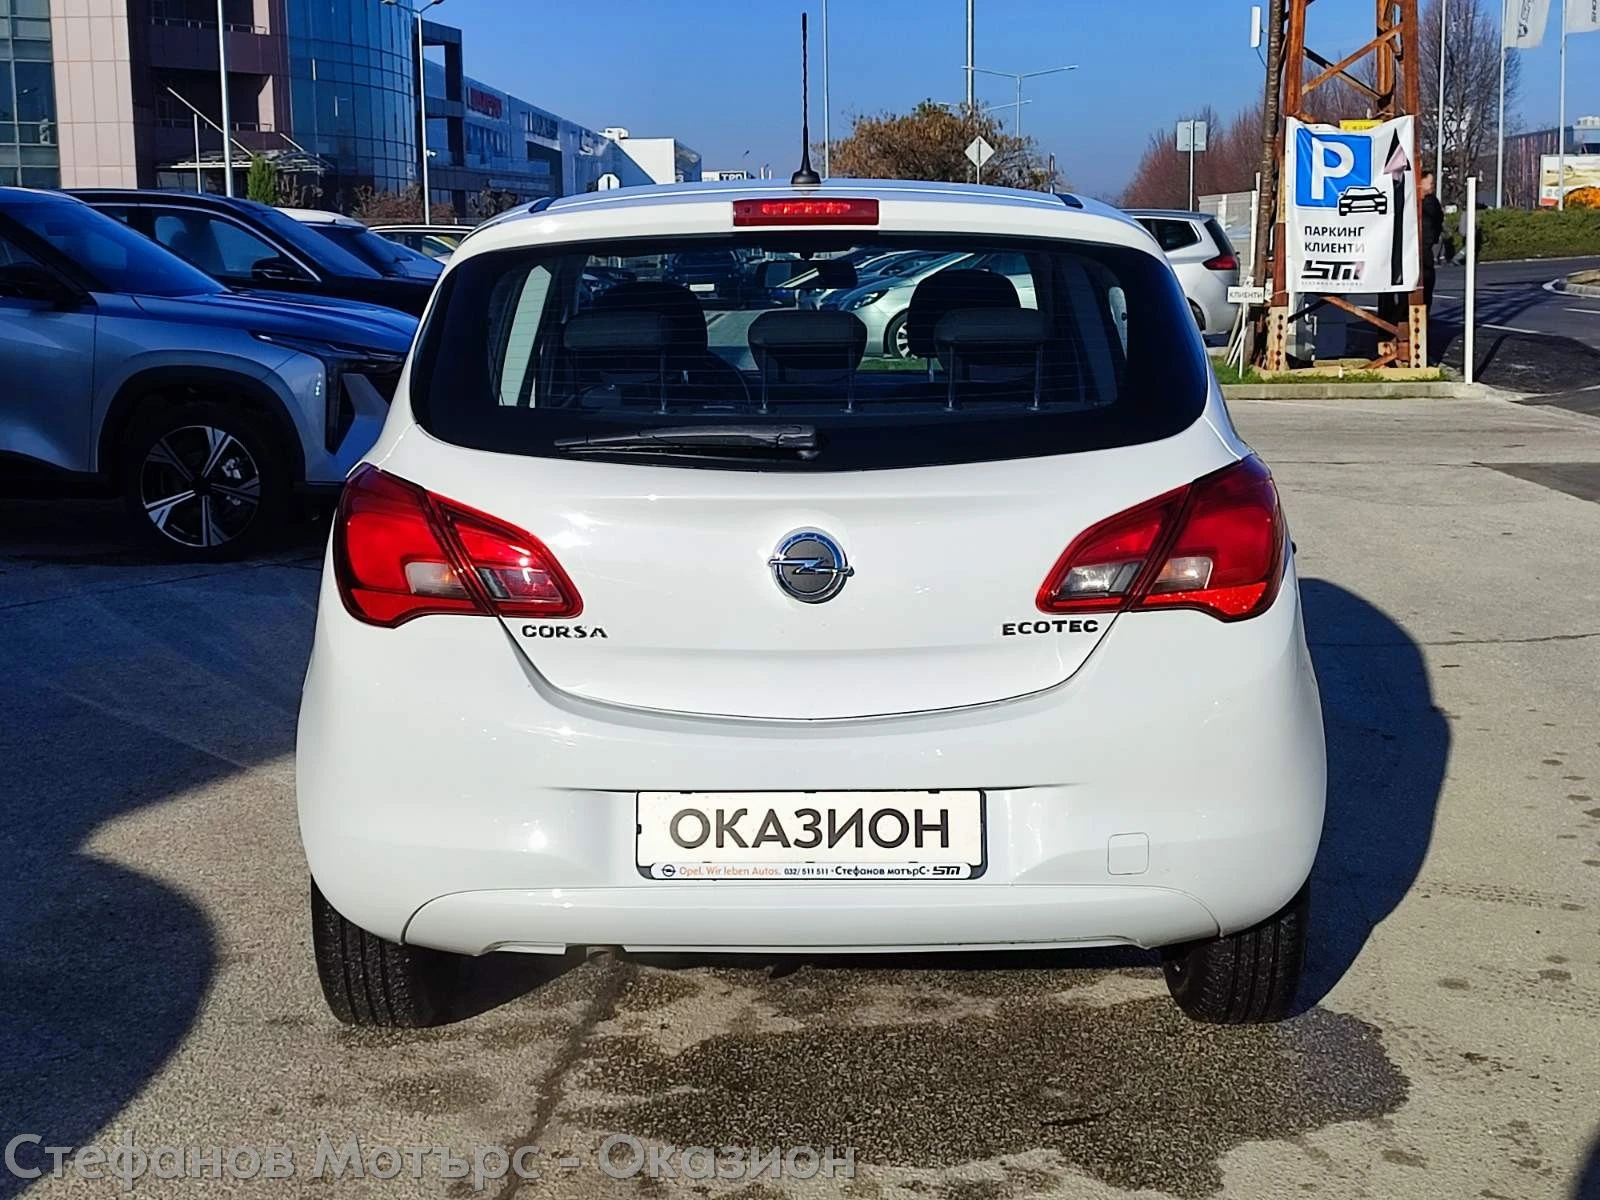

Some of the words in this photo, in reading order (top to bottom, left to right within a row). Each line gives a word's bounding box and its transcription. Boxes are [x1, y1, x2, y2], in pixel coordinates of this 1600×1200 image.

[1311, 136, 1355, 199] P
[1304, 226, 1364, 236] ПАРКИНГ
[1304, 242, 1364, 253] КЛИЕНТИ
[522, 625, 608, 638] CORSA
[1002, 620, 1098, 635] ECOTEC
[669, 808, 950, 848] ОКАЗИОН
[705, 866, 722, 876] Wir
[724, 865, 750, 876] leben
[802, 867, 815, 876] 511
[816, 867, 829, 876] 511
